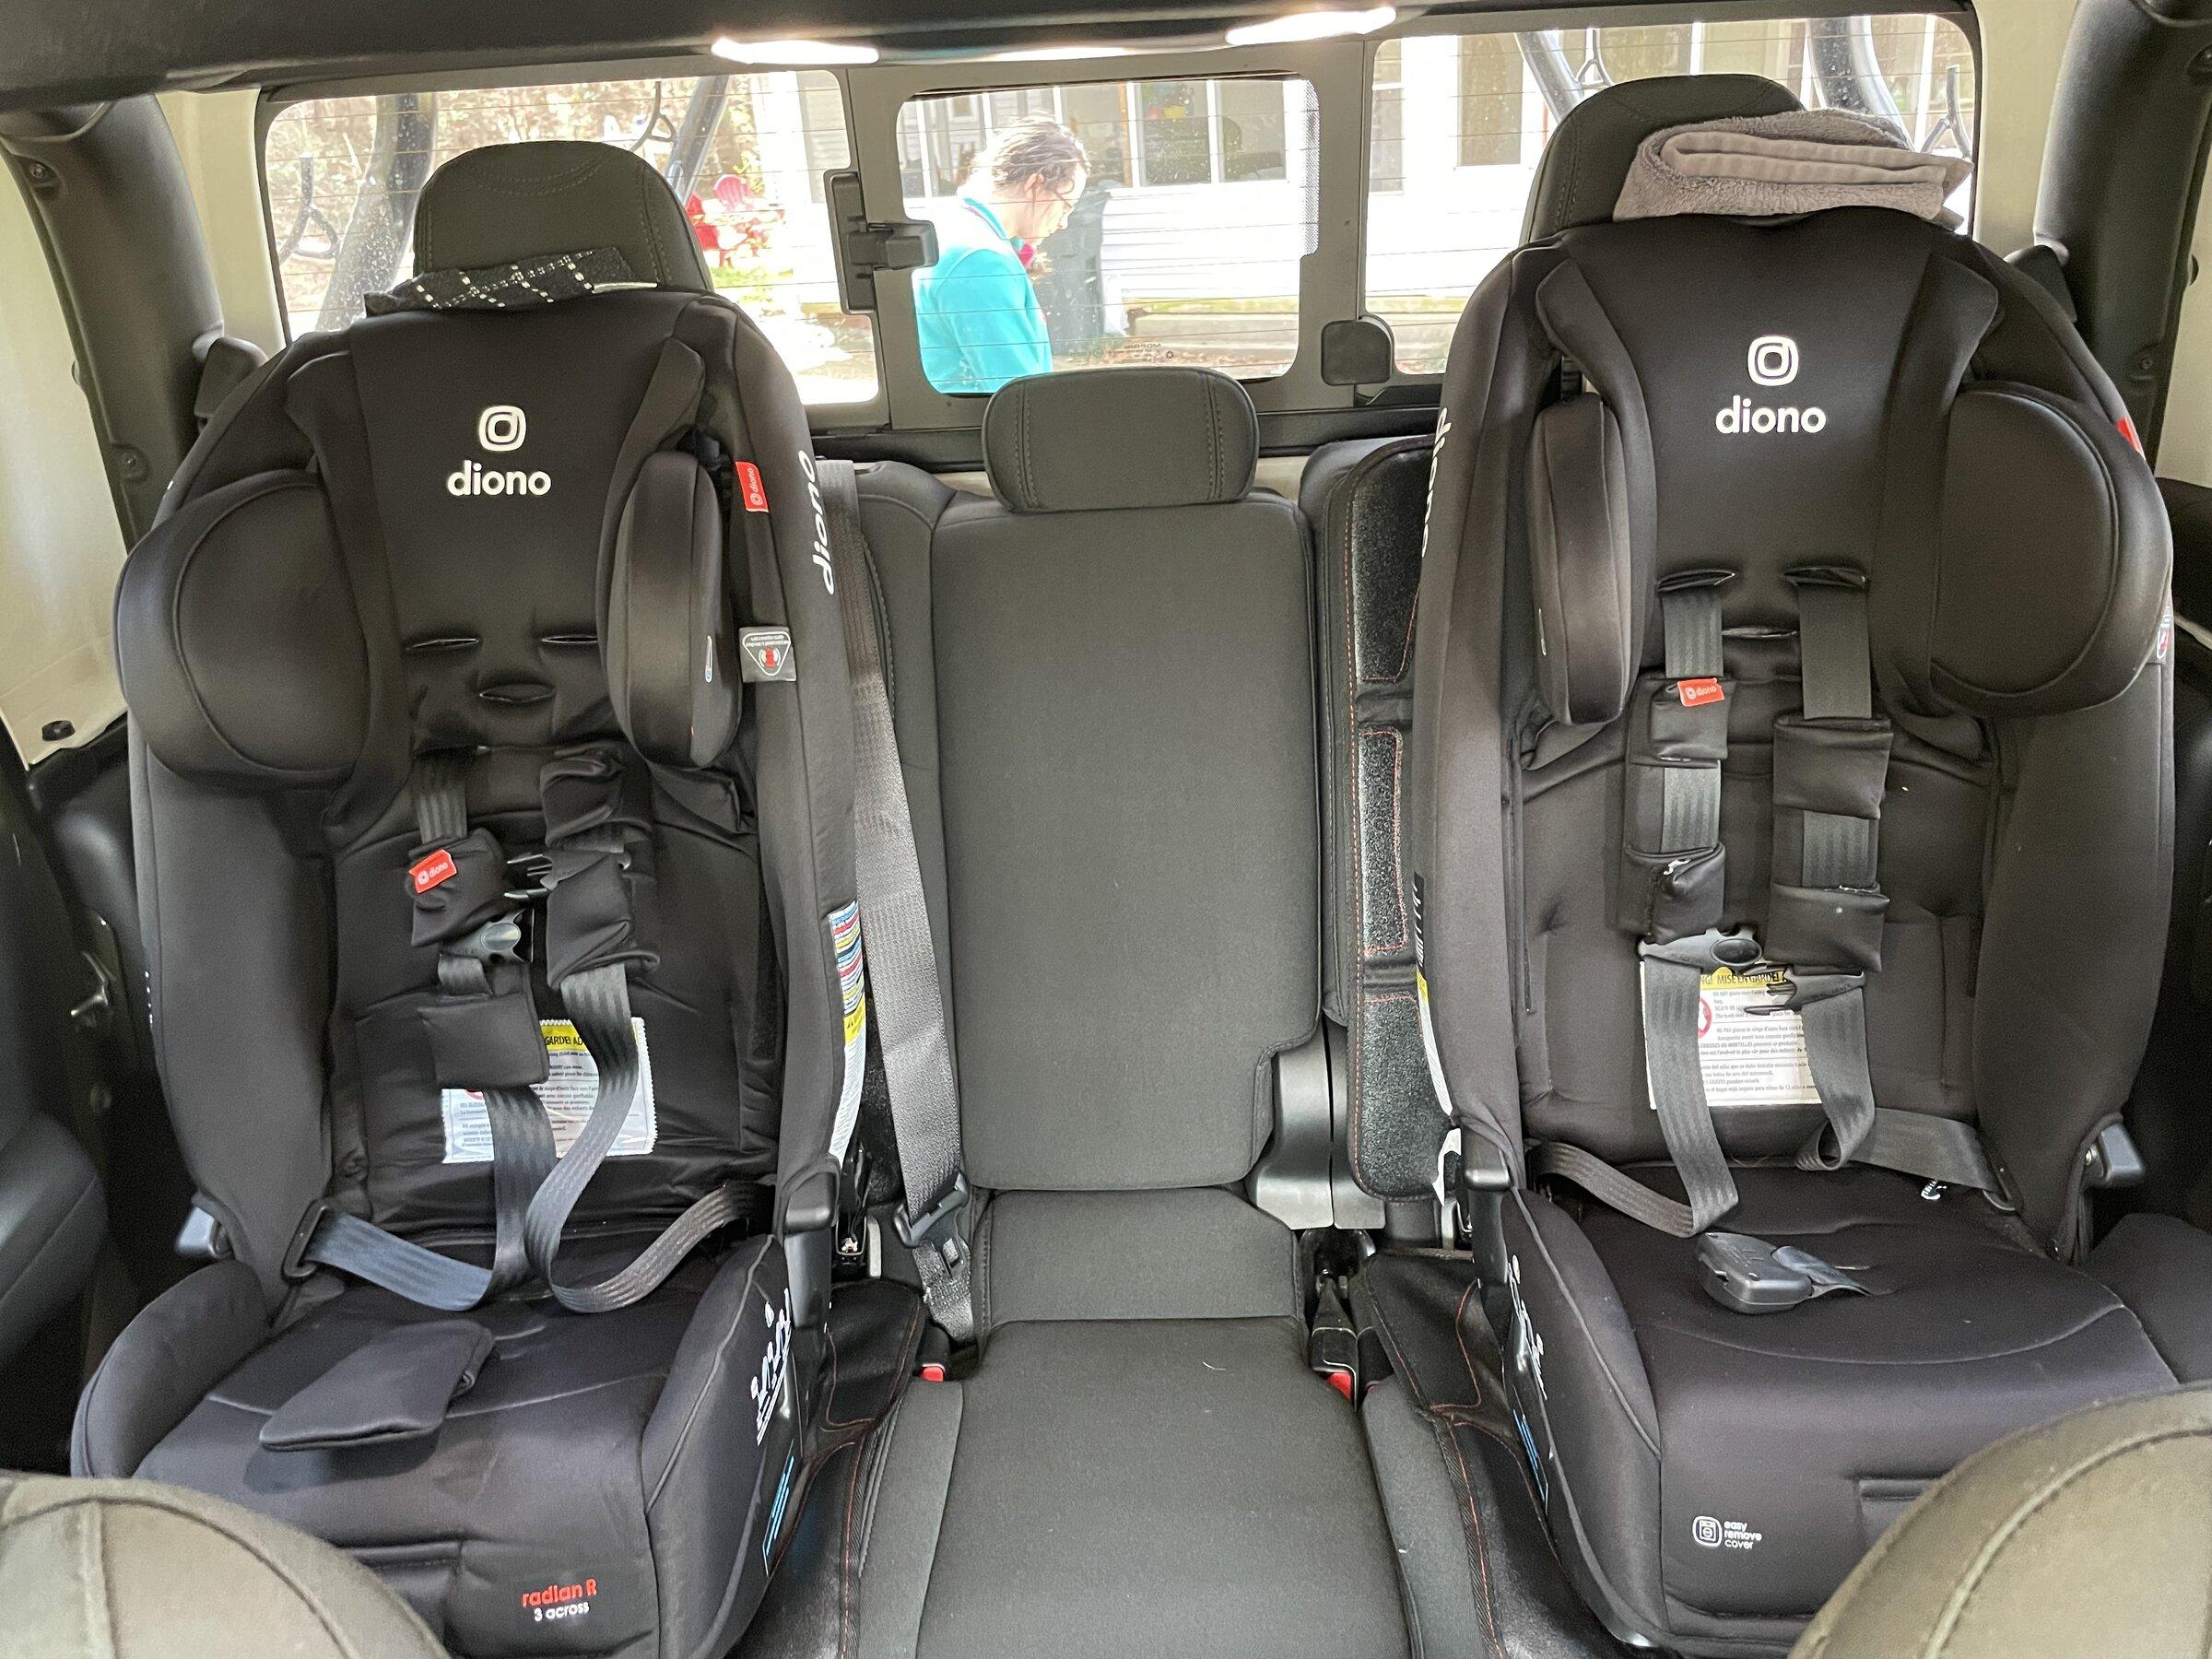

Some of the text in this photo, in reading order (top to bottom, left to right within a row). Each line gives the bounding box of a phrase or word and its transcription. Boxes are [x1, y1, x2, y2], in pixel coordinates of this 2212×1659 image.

[1714, 394, 1827, 434] diono
[447, 460, 552, 496] diono
[747, 467, 759, 493] diono
[797, 450, 835, 595] diono
[1696, 685, 1717, 697] diono
[429, 862, 449, 878] diono
[1724, 1521, 1747, 1532] easy
[1724, 1530, 1762, 1541] remove
[1724, 1539, 1753, 1549] cover
[522, 1578, 597, 1607] radian R
[534, 1601, 590, 1622] 3 across
